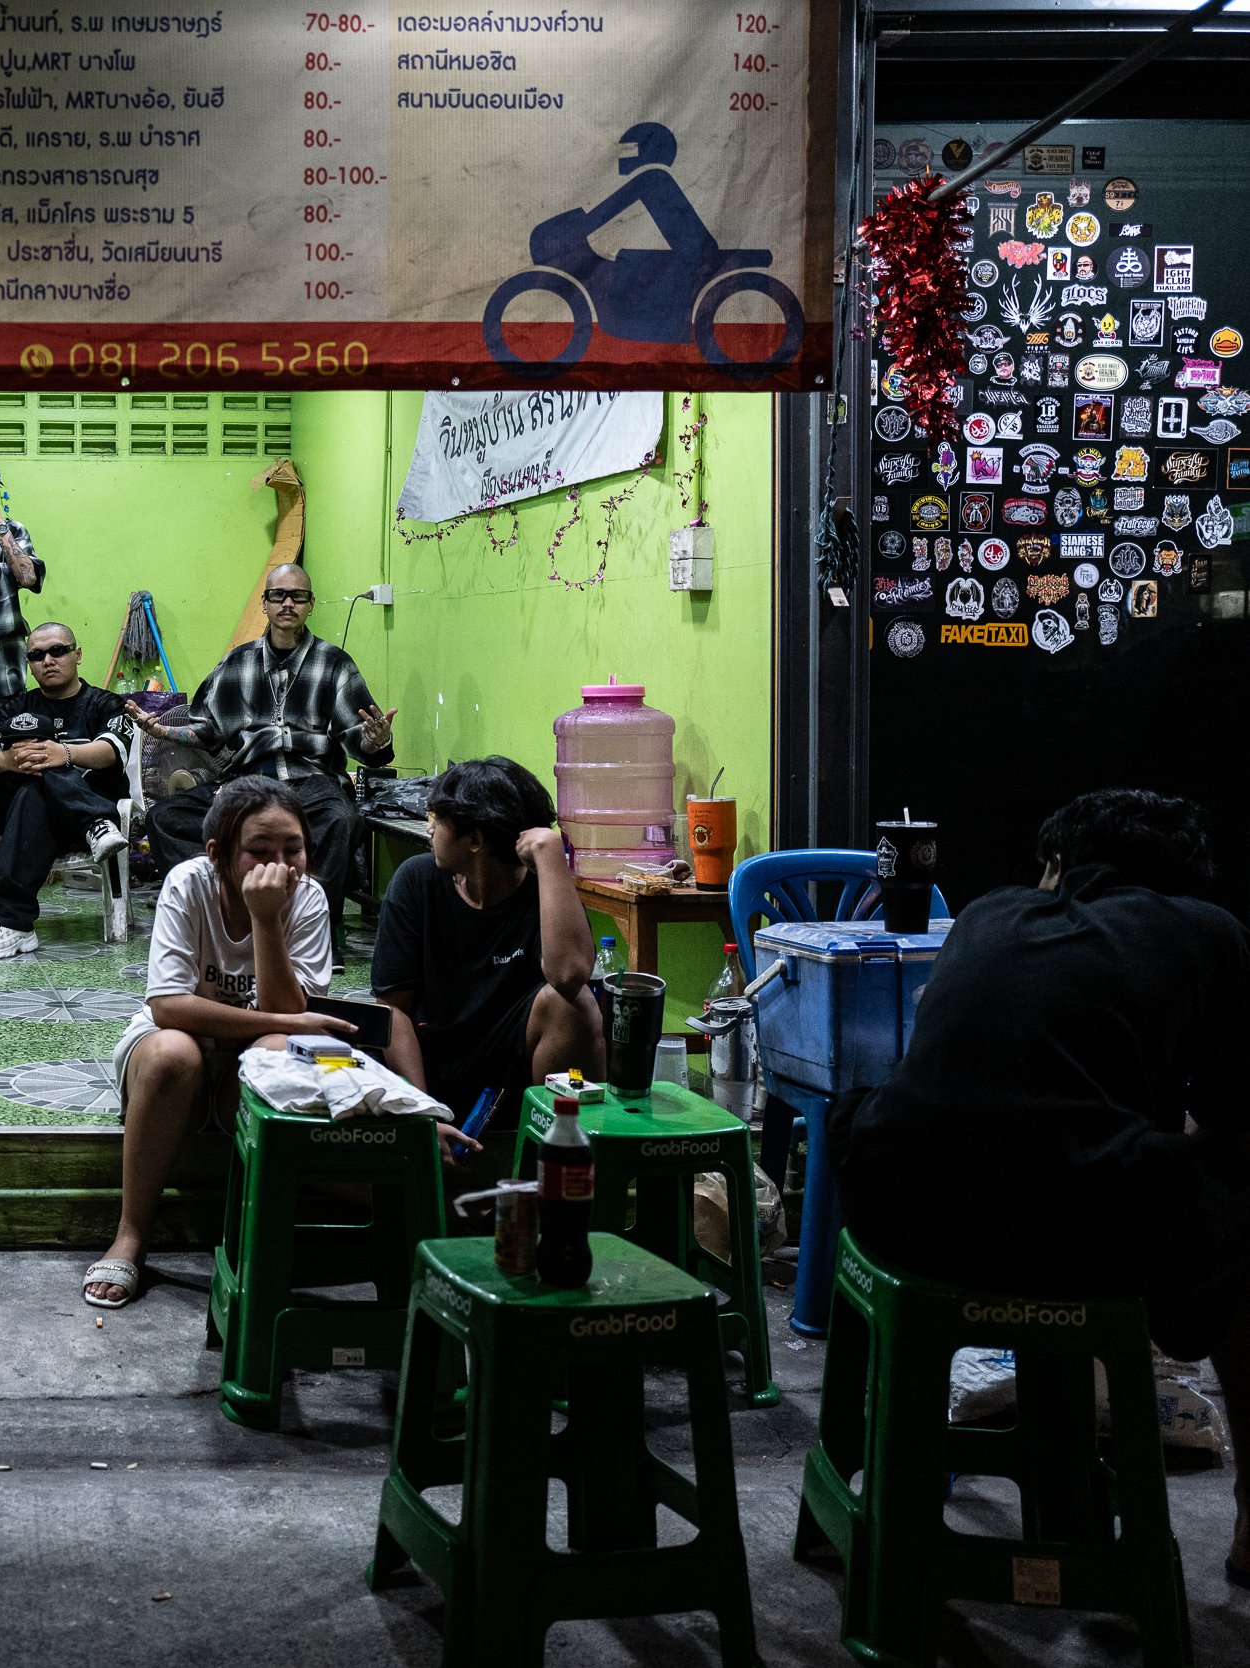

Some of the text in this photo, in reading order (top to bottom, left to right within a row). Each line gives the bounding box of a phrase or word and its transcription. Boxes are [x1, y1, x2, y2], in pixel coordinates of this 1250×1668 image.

[71, 16, 103, 32] ร.พ
[306, 12, 373, 32] 70-80.-
[398, 10, 603, 32] เดอะมอลล์งามวงศ์วาน
[737, 14, 780, 34] 120.-
[79, 48, 135, 71] บางโพ
[305, 52, 340, 71] 80.-
[398, 49, 516, 70] สถานีหมอชิต
[735, 54, 779, 72] 140.-
[65, 87, 175, 110] MRTบางอ้อ,
[184, 87, 224, 108] ยันฮี
[304, 91, 341, 109] 80.-
[398, 88, 563, 109] สนามบินดอนเมือง
[730, 93, 778, 111] 200.-
[26, 132, 90, 149] แคราย,
[99, 131, 131, 147] ร.พ
[140, 124, 200, 147] บำราศ
[304, 129, 341, 147] 80.-
[304, 166, 387, 185] 80-100.-
[27, 198, 95, 224] แม็คโคร
[104, 207, 174, 224] พระราม
[183, 206, 194, 224] 5
[304, 205, 340, 223] 80.-
[8, 232, 93, 263] ประชาชื่น,
[102, 240, 222, 262] วัดเสมียนนารี
[305, 243, 353, 261] 100.-
[305, 281, 352, 300] 100.-
[1176, 345, 1195, 354] LIFE
[69, 341, 369, 378] 081 206 5260
[1078, 449, 1102, 458] FLY WAY
[1062, 535, 1103, 545] SIAMESE
[1062, 546, 1103, 556] GANGTA
[310, 1126, 397, 1145] GrabFood
[641, 1138, 721, 1157] GrabFood
[569, 1308, 677, 1338] GrabFood
[962, 1301, 1087, 1327] GrabFood
